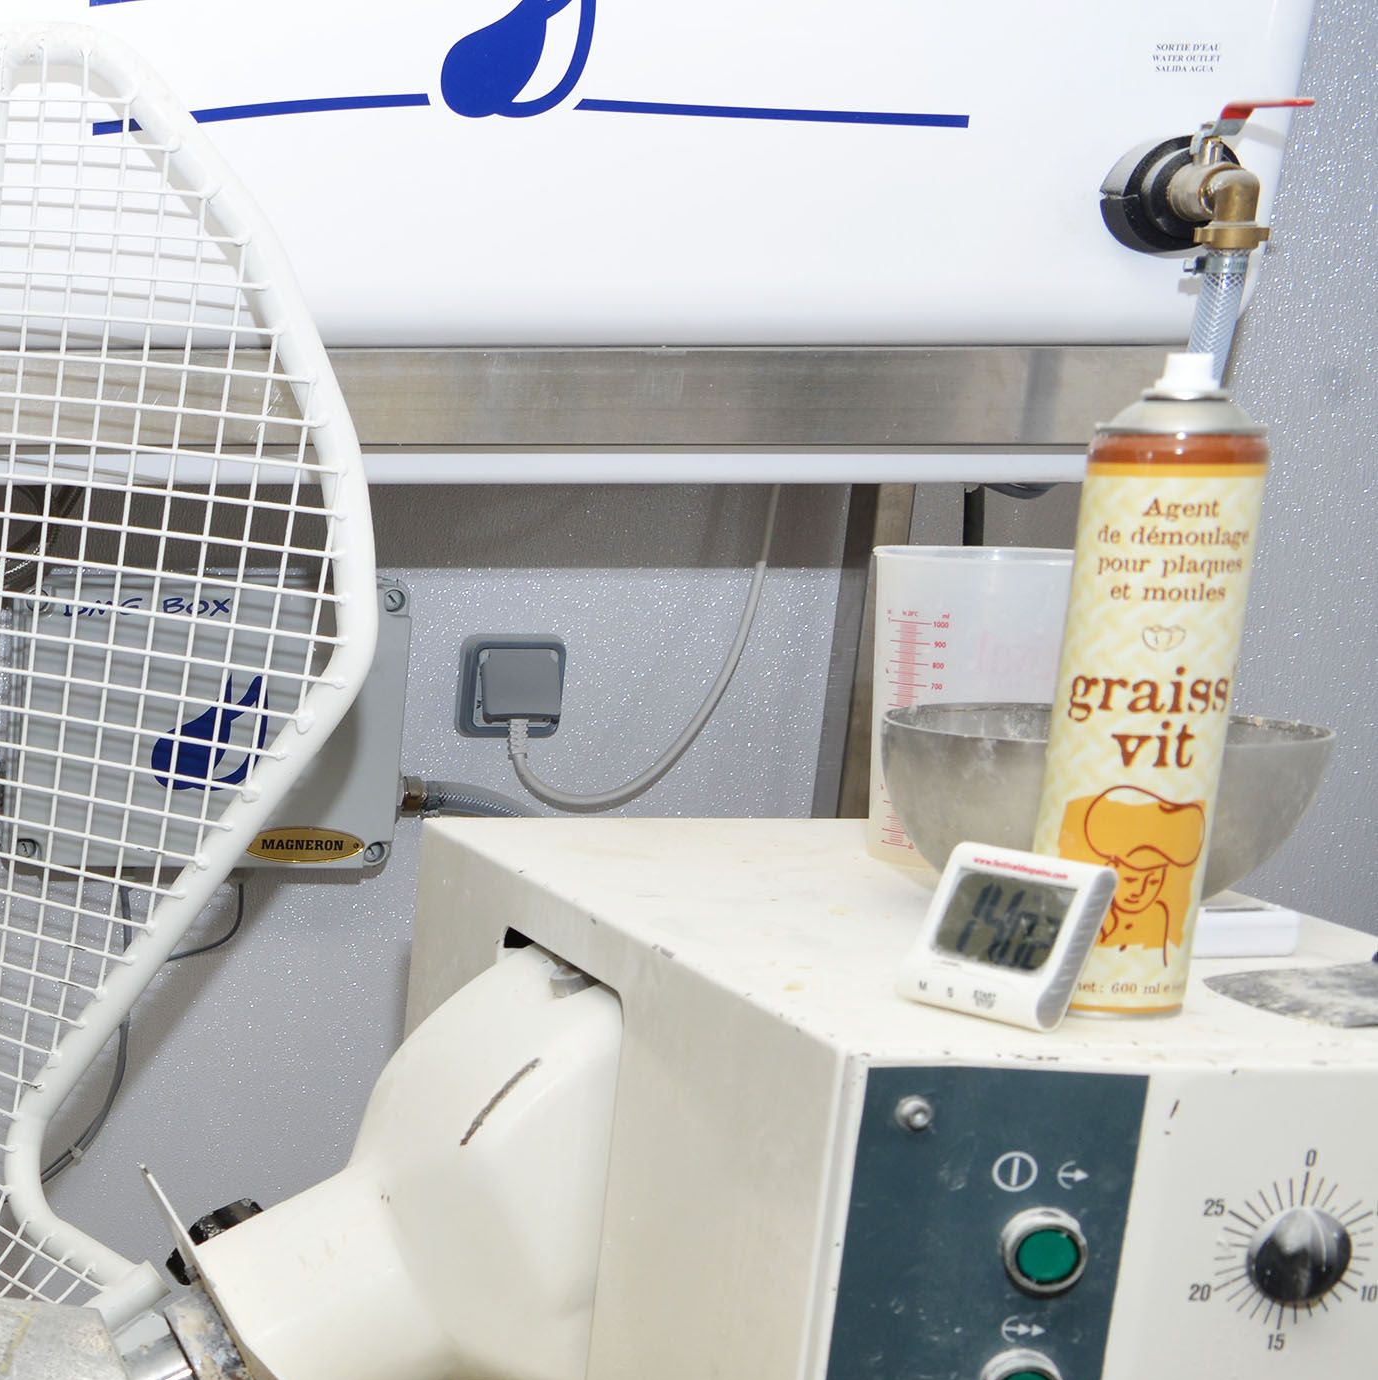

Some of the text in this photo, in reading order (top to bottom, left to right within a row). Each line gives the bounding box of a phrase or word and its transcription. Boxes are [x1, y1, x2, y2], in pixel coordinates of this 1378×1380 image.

[1156, 43, 1190, 51] SORTIE
[1152, 54, 1221, 62] WATER OUTLET
[1155, 65, 1214, 73] SALIDA AGUA
[1142, 498, 1220, 519] Agent
[1097, 525, 1249, 550] de démoulage
[1097, 556, 1243, 579] pour plaques
[1110, 583, 1226, 602] et moules
[162, 597, 231, 617] BOX
[933, 621, 950, 629] 1000
[933, 641, 947, 649] 900
[932, 662, 945, 670] 800
[1111, 721, 1196, 769] vit
[261, 839, 344, 851] MAGNERON
[1111, 982, 1138, 994] 600
[1144, 983, 1161, 995] ml
[1203, 1199, 1225, 1216] 25
[1189, 1284, 1212, 1301] 20
[1361, 1285, 1378, 1302] 10
[1267, 1334, 1285, 1350] 15
